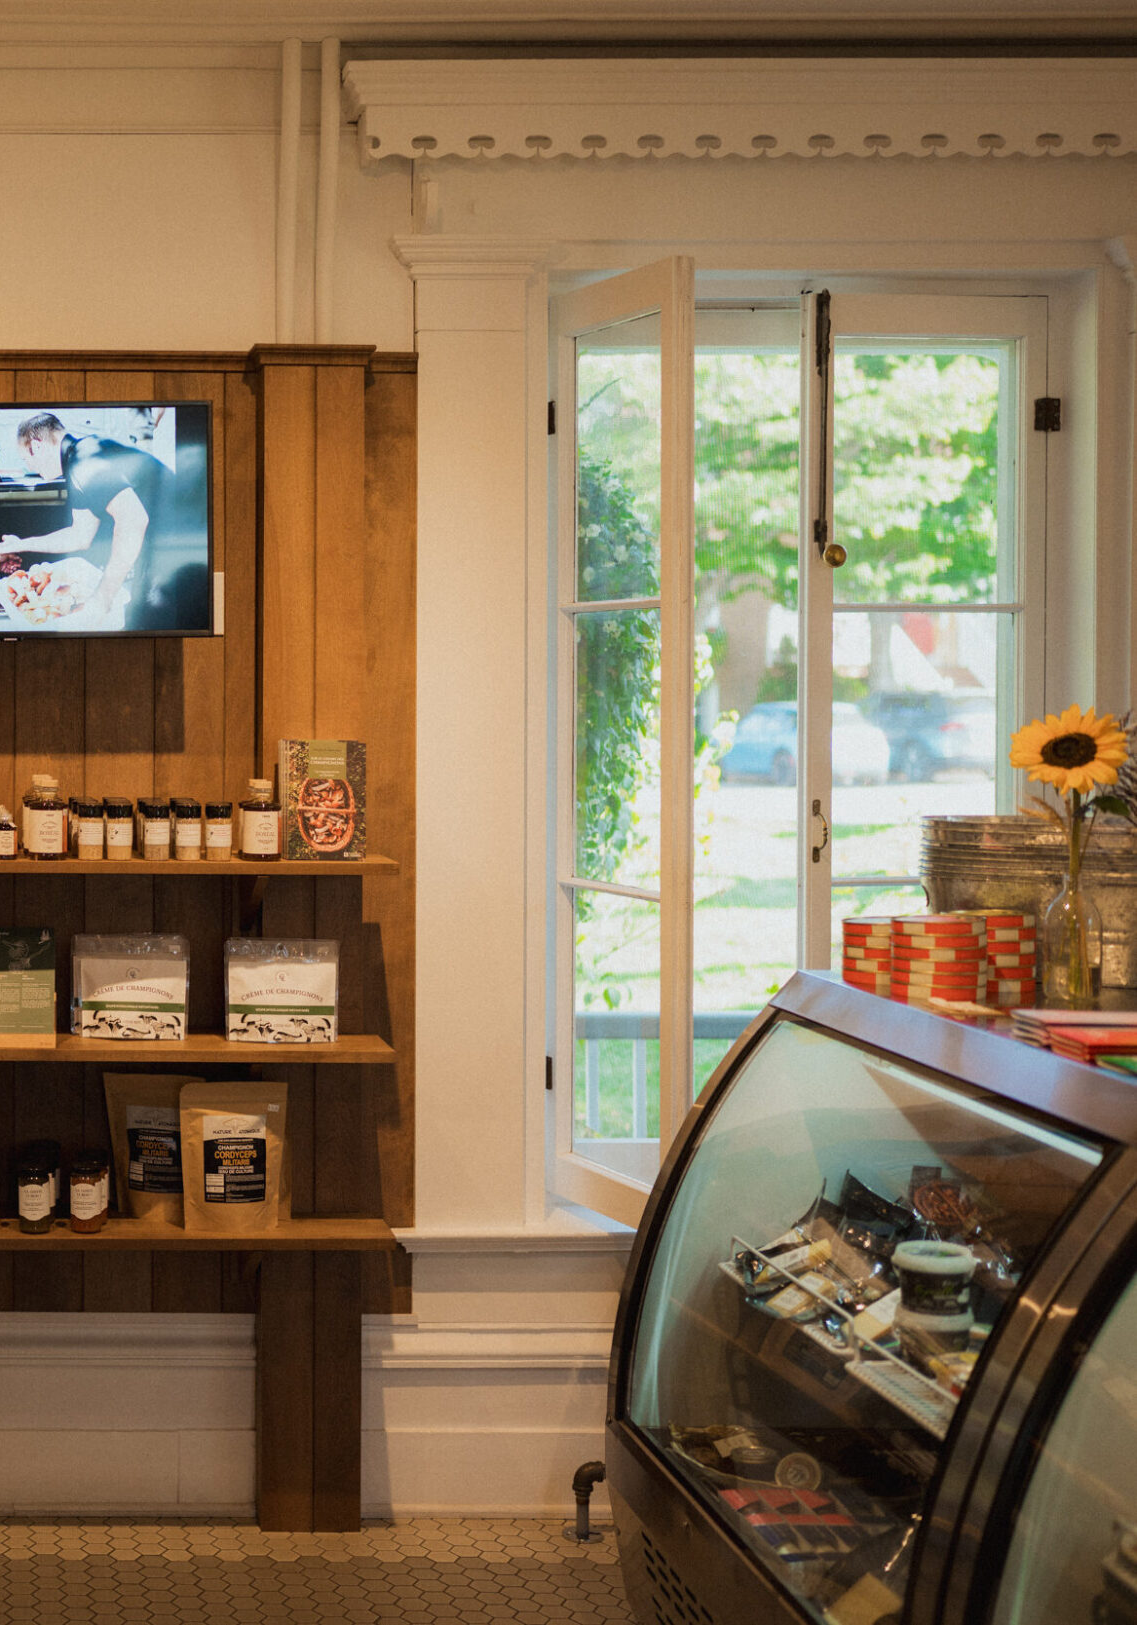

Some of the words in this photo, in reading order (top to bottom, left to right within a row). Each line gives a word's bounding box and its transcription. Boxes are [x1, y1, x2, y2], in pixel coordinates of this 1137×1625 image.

[126, 985, 174, 1001] CHAMPIGNONS
[275, 988, 324, 1003] CHAMPIGNONS
[214, 1150, 257, 1160] CORDYCEPS
